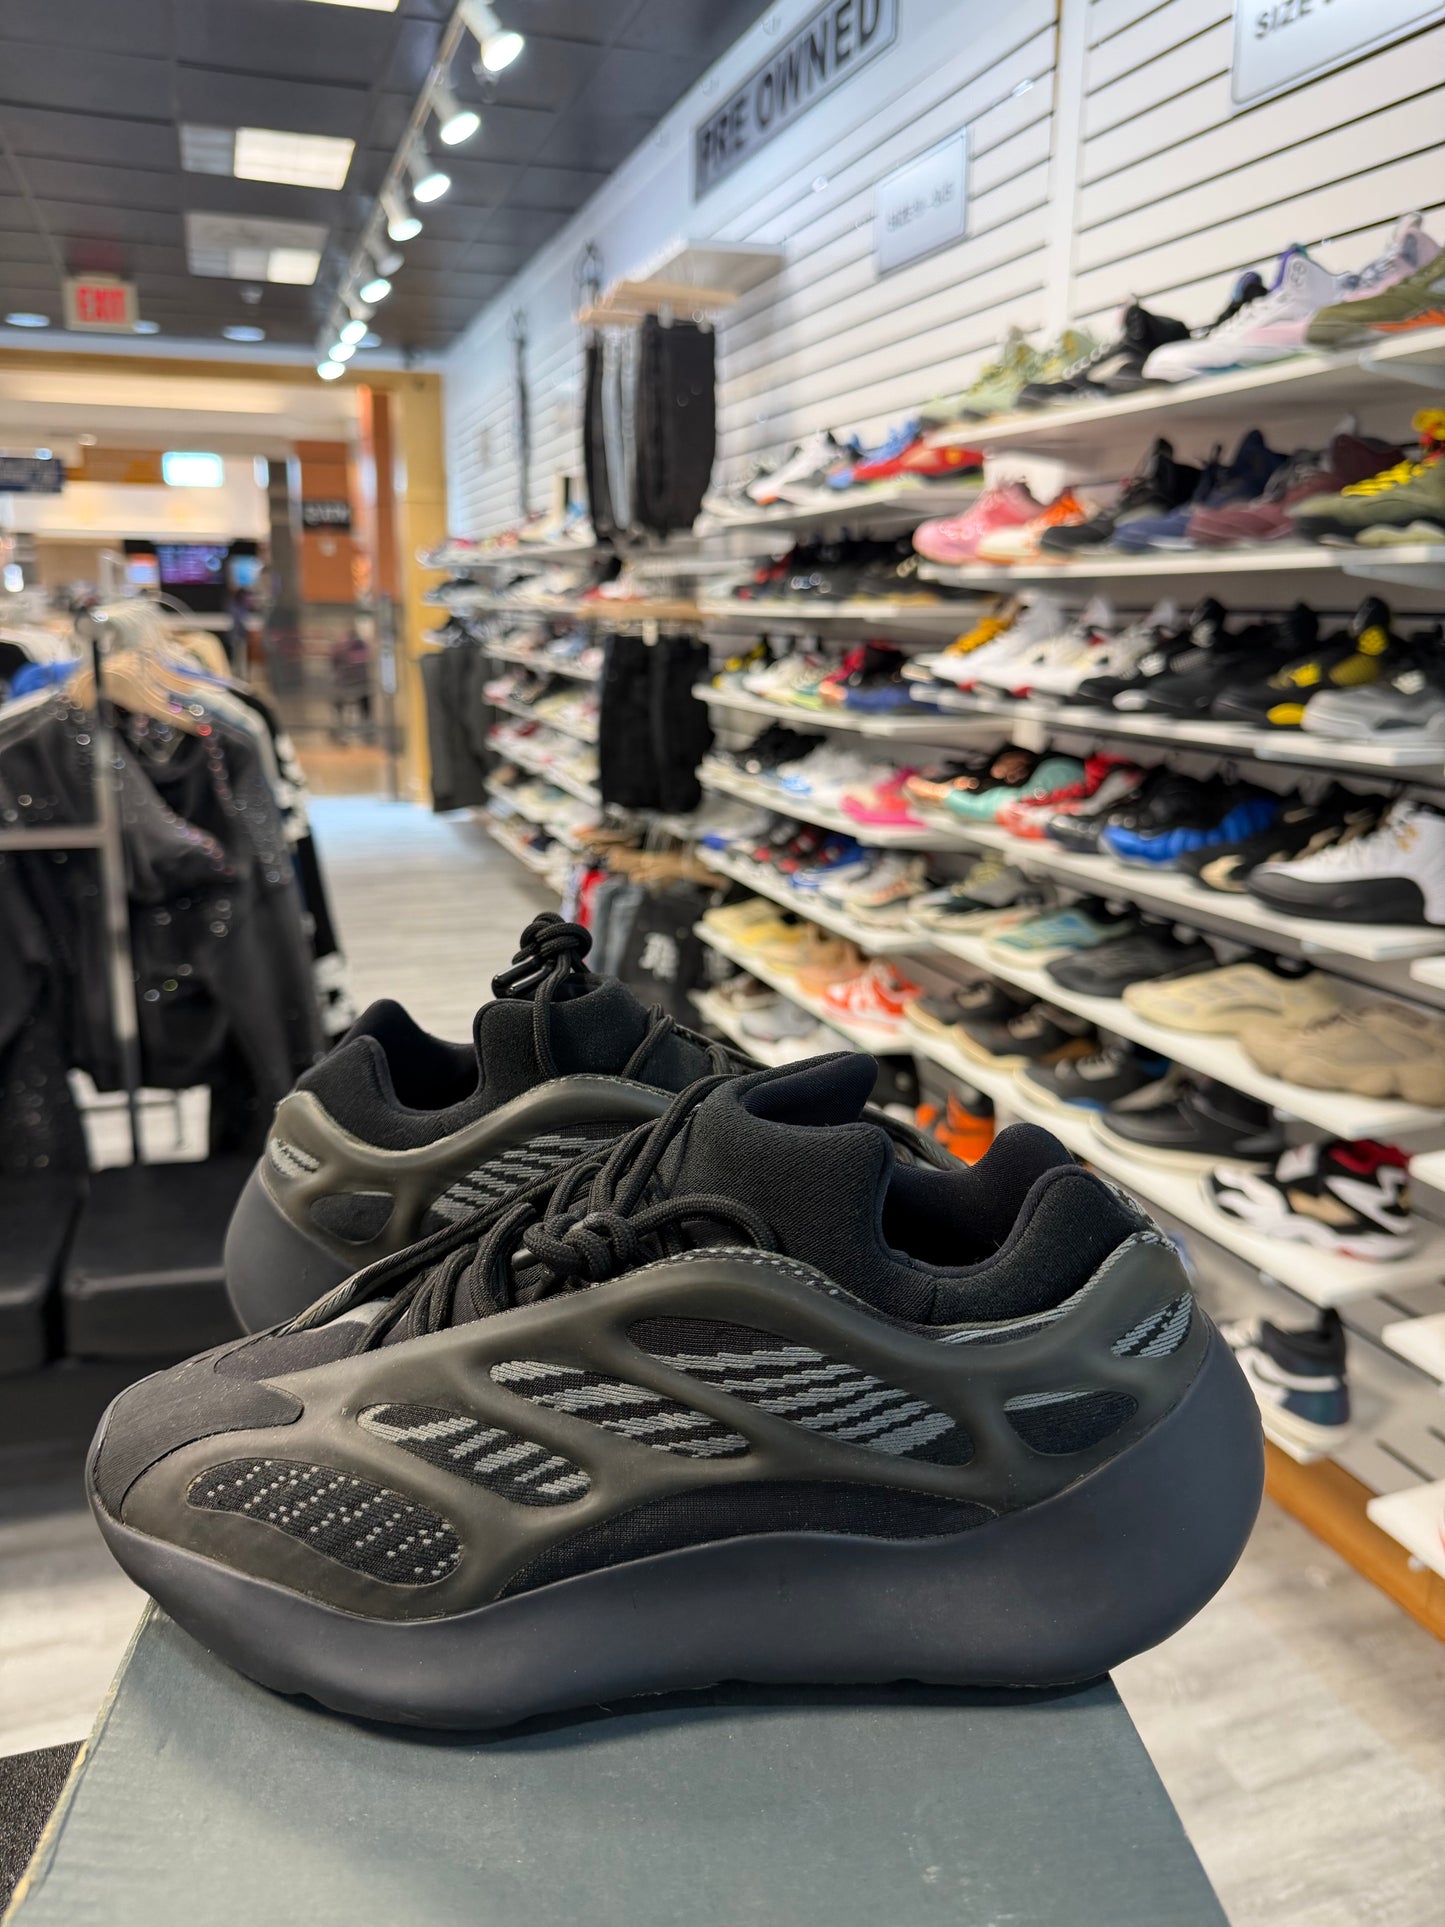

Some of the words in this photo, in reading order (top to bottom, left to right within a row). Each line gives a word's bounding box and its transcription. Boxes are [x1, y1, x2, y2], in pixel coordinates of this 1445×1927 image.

[702, 95, 747, 168] PRE
[755, 0, 880, 131] OWNED
[76, 286, 126, 324] EXIT
